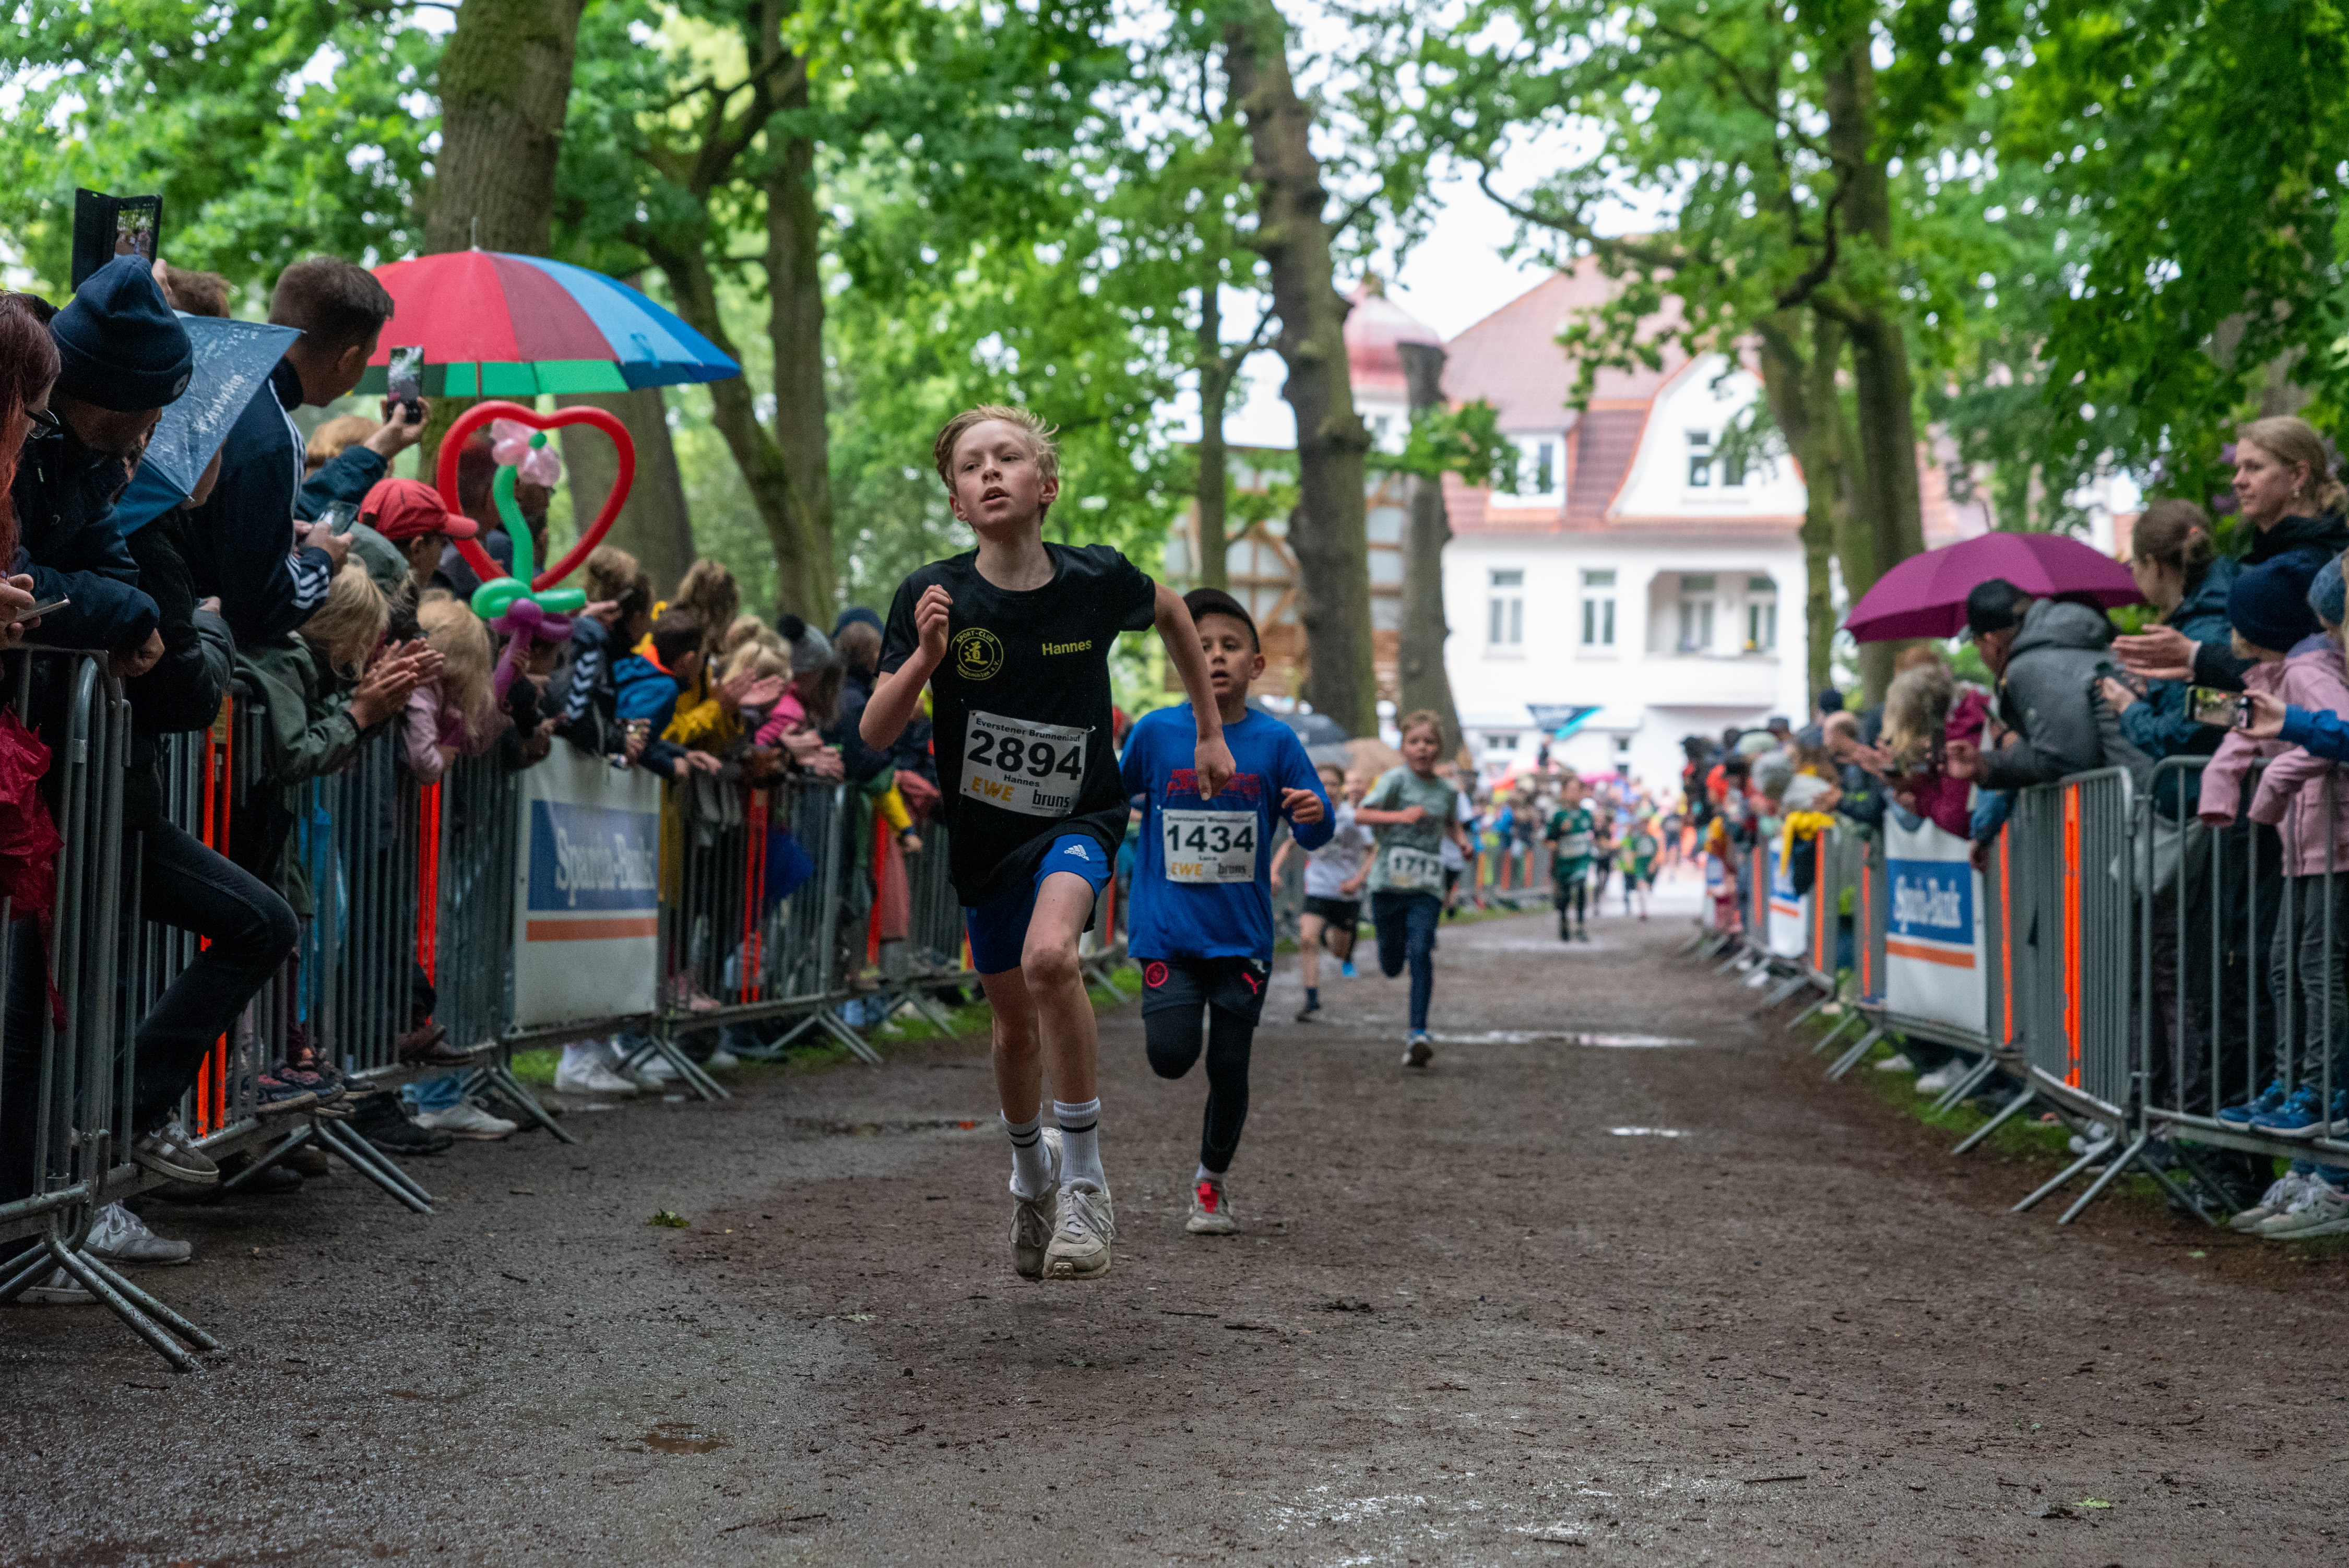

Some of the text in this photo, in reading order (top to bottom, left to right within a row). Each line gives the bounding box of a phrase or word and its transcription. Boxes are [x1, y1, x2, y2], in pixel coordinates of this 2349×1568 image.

[957, 631, 994, 643] SPORT-CLUB
[1042, 638, 1092, 657] Hannes
[976, 718, 1081, 742] Everstener Brunnenlauf
[967, 729, 1082, 780] 2894
[971, 776, 1015, 802] EWE
[1004, 775, 1040, 787] Hannes
[1033, 789, 1070, 808] bruns
[1167, 825, 1254, 852] 1434
[1064, 849, 1089, 861] adidas
[1171, 862, 1203, 876] EWE
[1218, 862, 1247, 875] bruns
